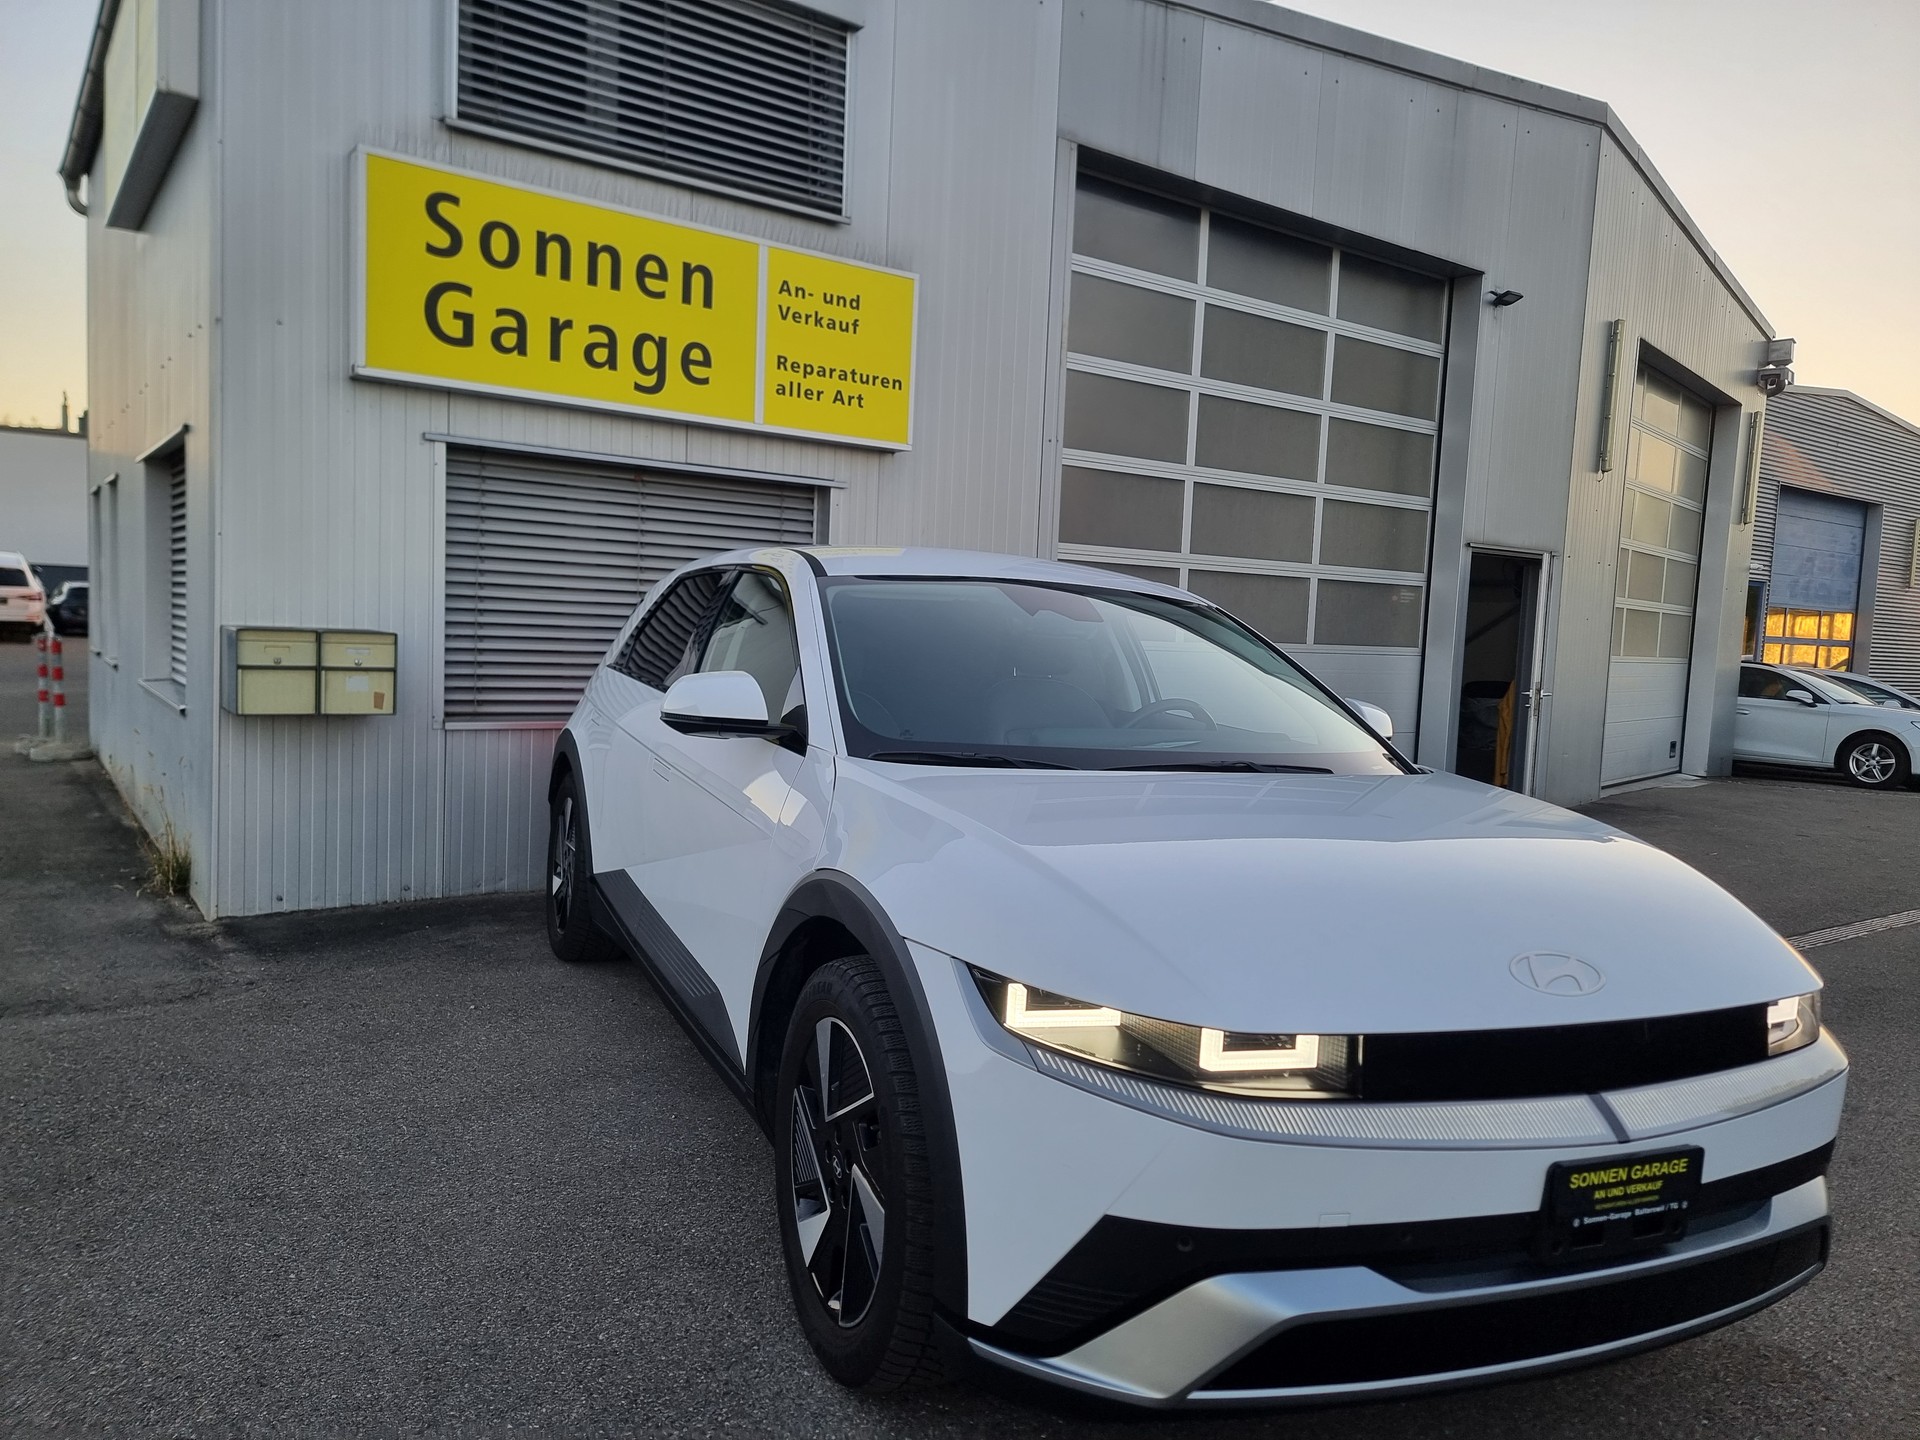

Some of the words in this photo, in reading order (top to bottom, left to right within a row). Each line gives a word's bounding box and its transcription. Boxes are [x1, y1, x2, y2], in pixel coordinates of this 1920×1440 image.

[424, 191, 715, 310] Sonnen
[778, 279, 815, 301] An-
[822, 291, 861, 311] und
[777, 304, 861, 335] Verkauf
[423, 281, 714, 395] Garage
[776, 354, 903, 391] Reparaturen
[775, 381, 825, 402] aller
[832, 389, 864, 409] Art
[1569, 1167, 1627, 1188] SONNEN
[1631, 1159, 1689, 1179] GARAGE
[1594, 1189, 1605, 1200] AN
[1607, 1187, 1625, 1198] UND
[1626, 1180, 1664, 1195] VERKAUF
